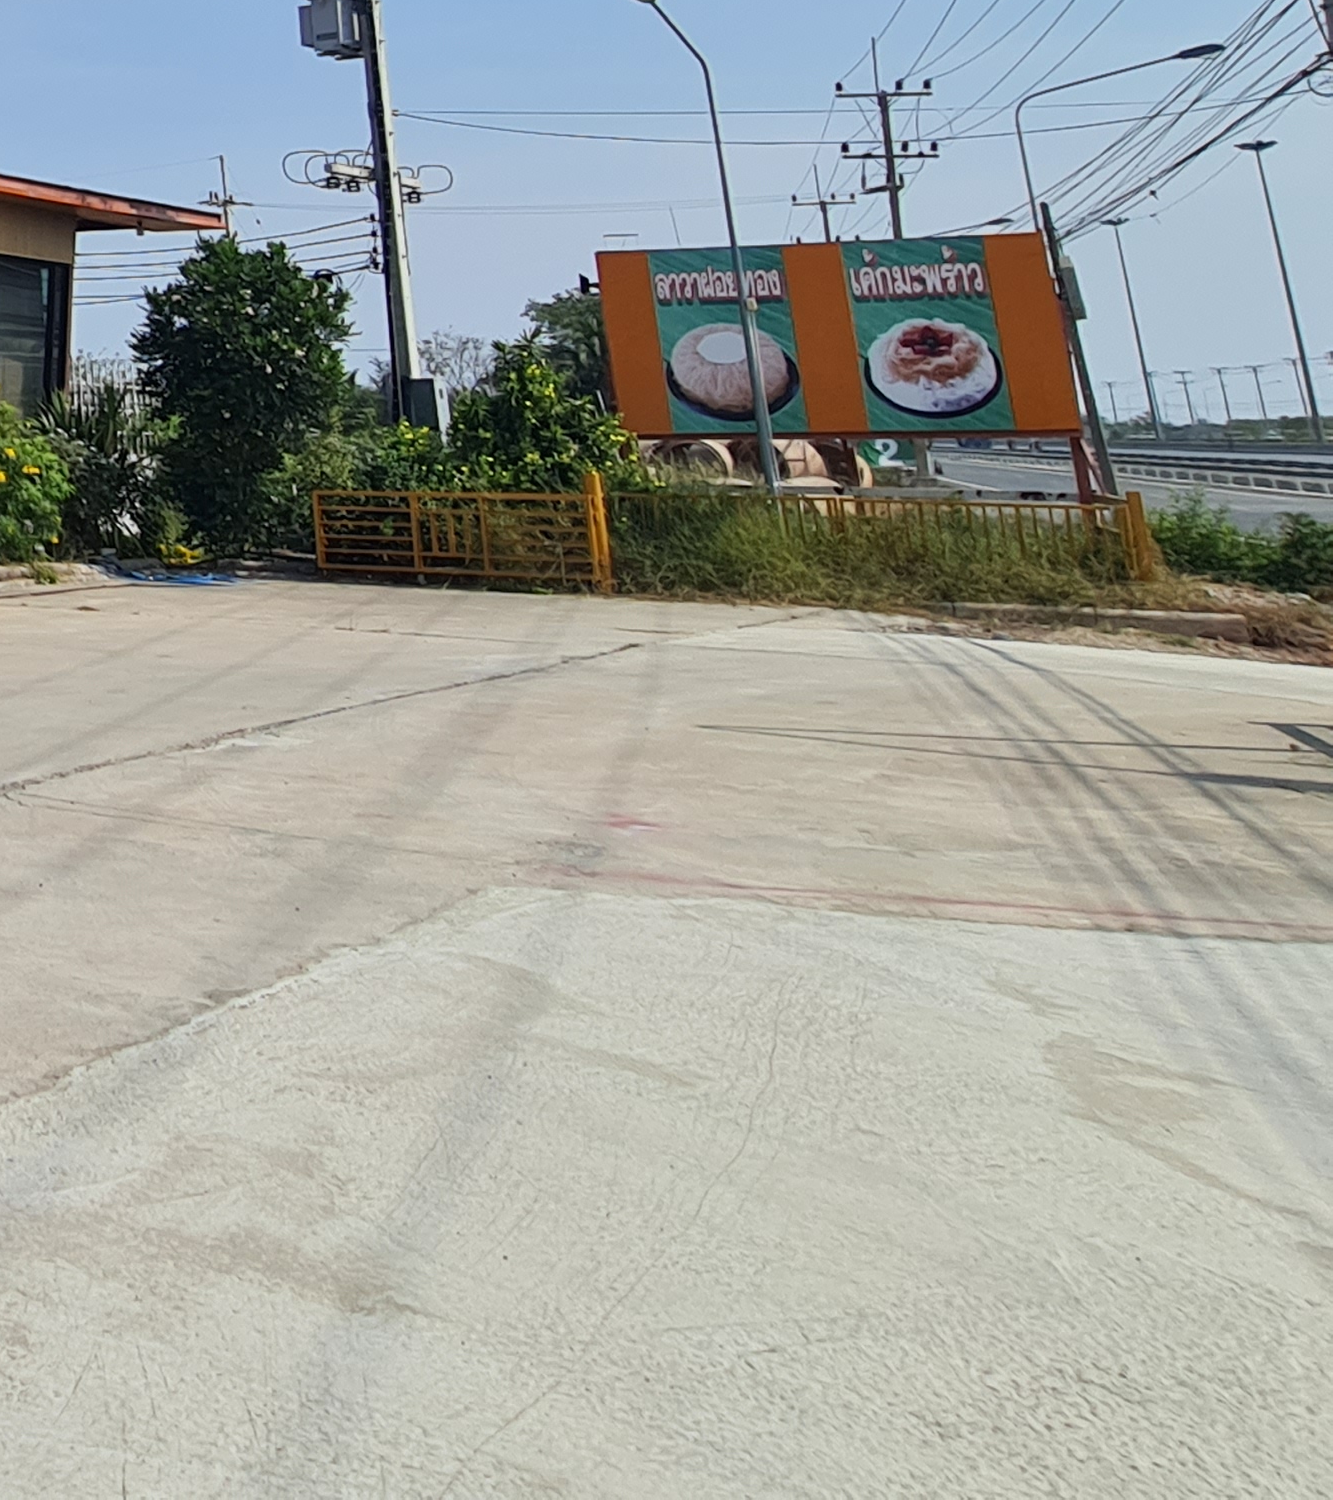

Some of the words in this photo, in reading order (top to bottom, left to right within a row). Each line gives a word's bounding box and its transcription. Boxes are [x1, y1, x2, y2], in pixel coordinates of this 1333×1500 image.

[849, 244, 986, 299] เค้กมะพร้าว
